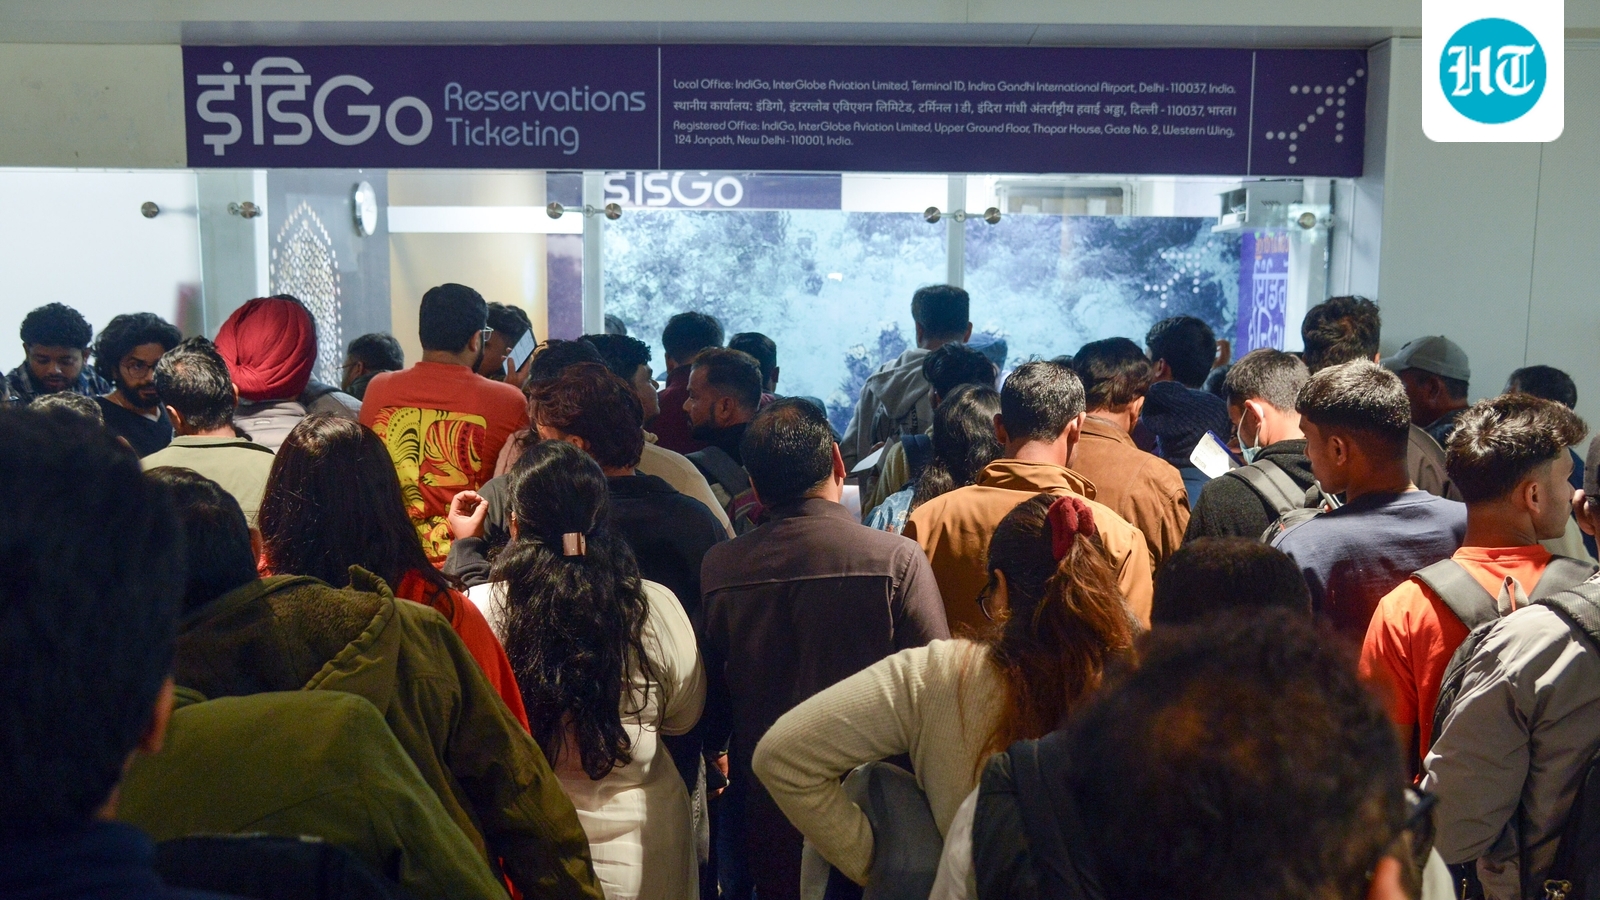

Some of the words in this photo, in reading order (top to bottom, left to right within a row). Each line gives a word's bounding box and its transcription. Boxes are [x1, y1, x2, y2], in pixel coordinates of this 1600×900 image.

[444, 82, 647, 111] Reservations
[673, 78, 699, 91] Local
[700, 78, 734, 91] Office:
[735, 77, 772, 91] IndiGo,
[772, 78, 827, 91] InterGlobe
[828, 78, 871, 91] Aviation
[871, 80, 910, 92] Limited,
[911, 79, 953, 92] Terminal
[967, 79, 996, 92] Indira
[997, 80, 1036, 93] Gandhi
[1036, 81, 1100, 93] International
[1100, 81, 1138, 96] Airport,
[1208, 83, 1236, 94] India.
[672, 97, 708, 112] स्थानीय
[709, 97, 753, 112] कार्यालय:
[755, 97, 787, 113] इंडिगो,
[788, 98, 831, 114] इंटरग्लोब
[832, 98, 874, 115] एविएशन
[875, 99, 916, 114] लिमिटेड,
[918, 99, 953, 114] टर्मिनल
[977, 99, 1003, 115] इंदिरा
[1004, 100, 1028, 115] गांधी
[1029, 100, 1075, 118] अंतर्राष्ट्रीय
[1076, 100, 1101, 117] हवाई
[1103, 104, 1127, 118] अड्डा,
[1129, 101, 1159, 116] दिल्ली
[445, 117, 580, 155] Ticketing
[673, 119, 727, 134] Registered
[727, 119, 760, 132] Office:
[761, 120, 797, 132] IndiGo,
[798, 120, 852, 133] InterGlobe
[853, 120, 895, 132] Aviation
[895, 121, 933, 134] Limited,
[934, 121, 965, 136] Upper
[965, 121, 1005, 133] Ground
[1005, 122, 1031, 135] Floor,
[1032, 122, 1068, 137] Thapar
[1068, 122, 1104, 137] House,
[1103, 122, 1131, 135] Gate
[1132, 123, 1149, 136] No.
[1151, 123, 1161, 136] 2,
[1162, 124, 1206, 136] Western
[1206, 125, 1235, 139] Wing,
[674, 133, 692, 146] 124
[693, 134, 735, 148] Janpath,
[736, 133, 760, 145] New
[826, 134, 854, 146] India.
